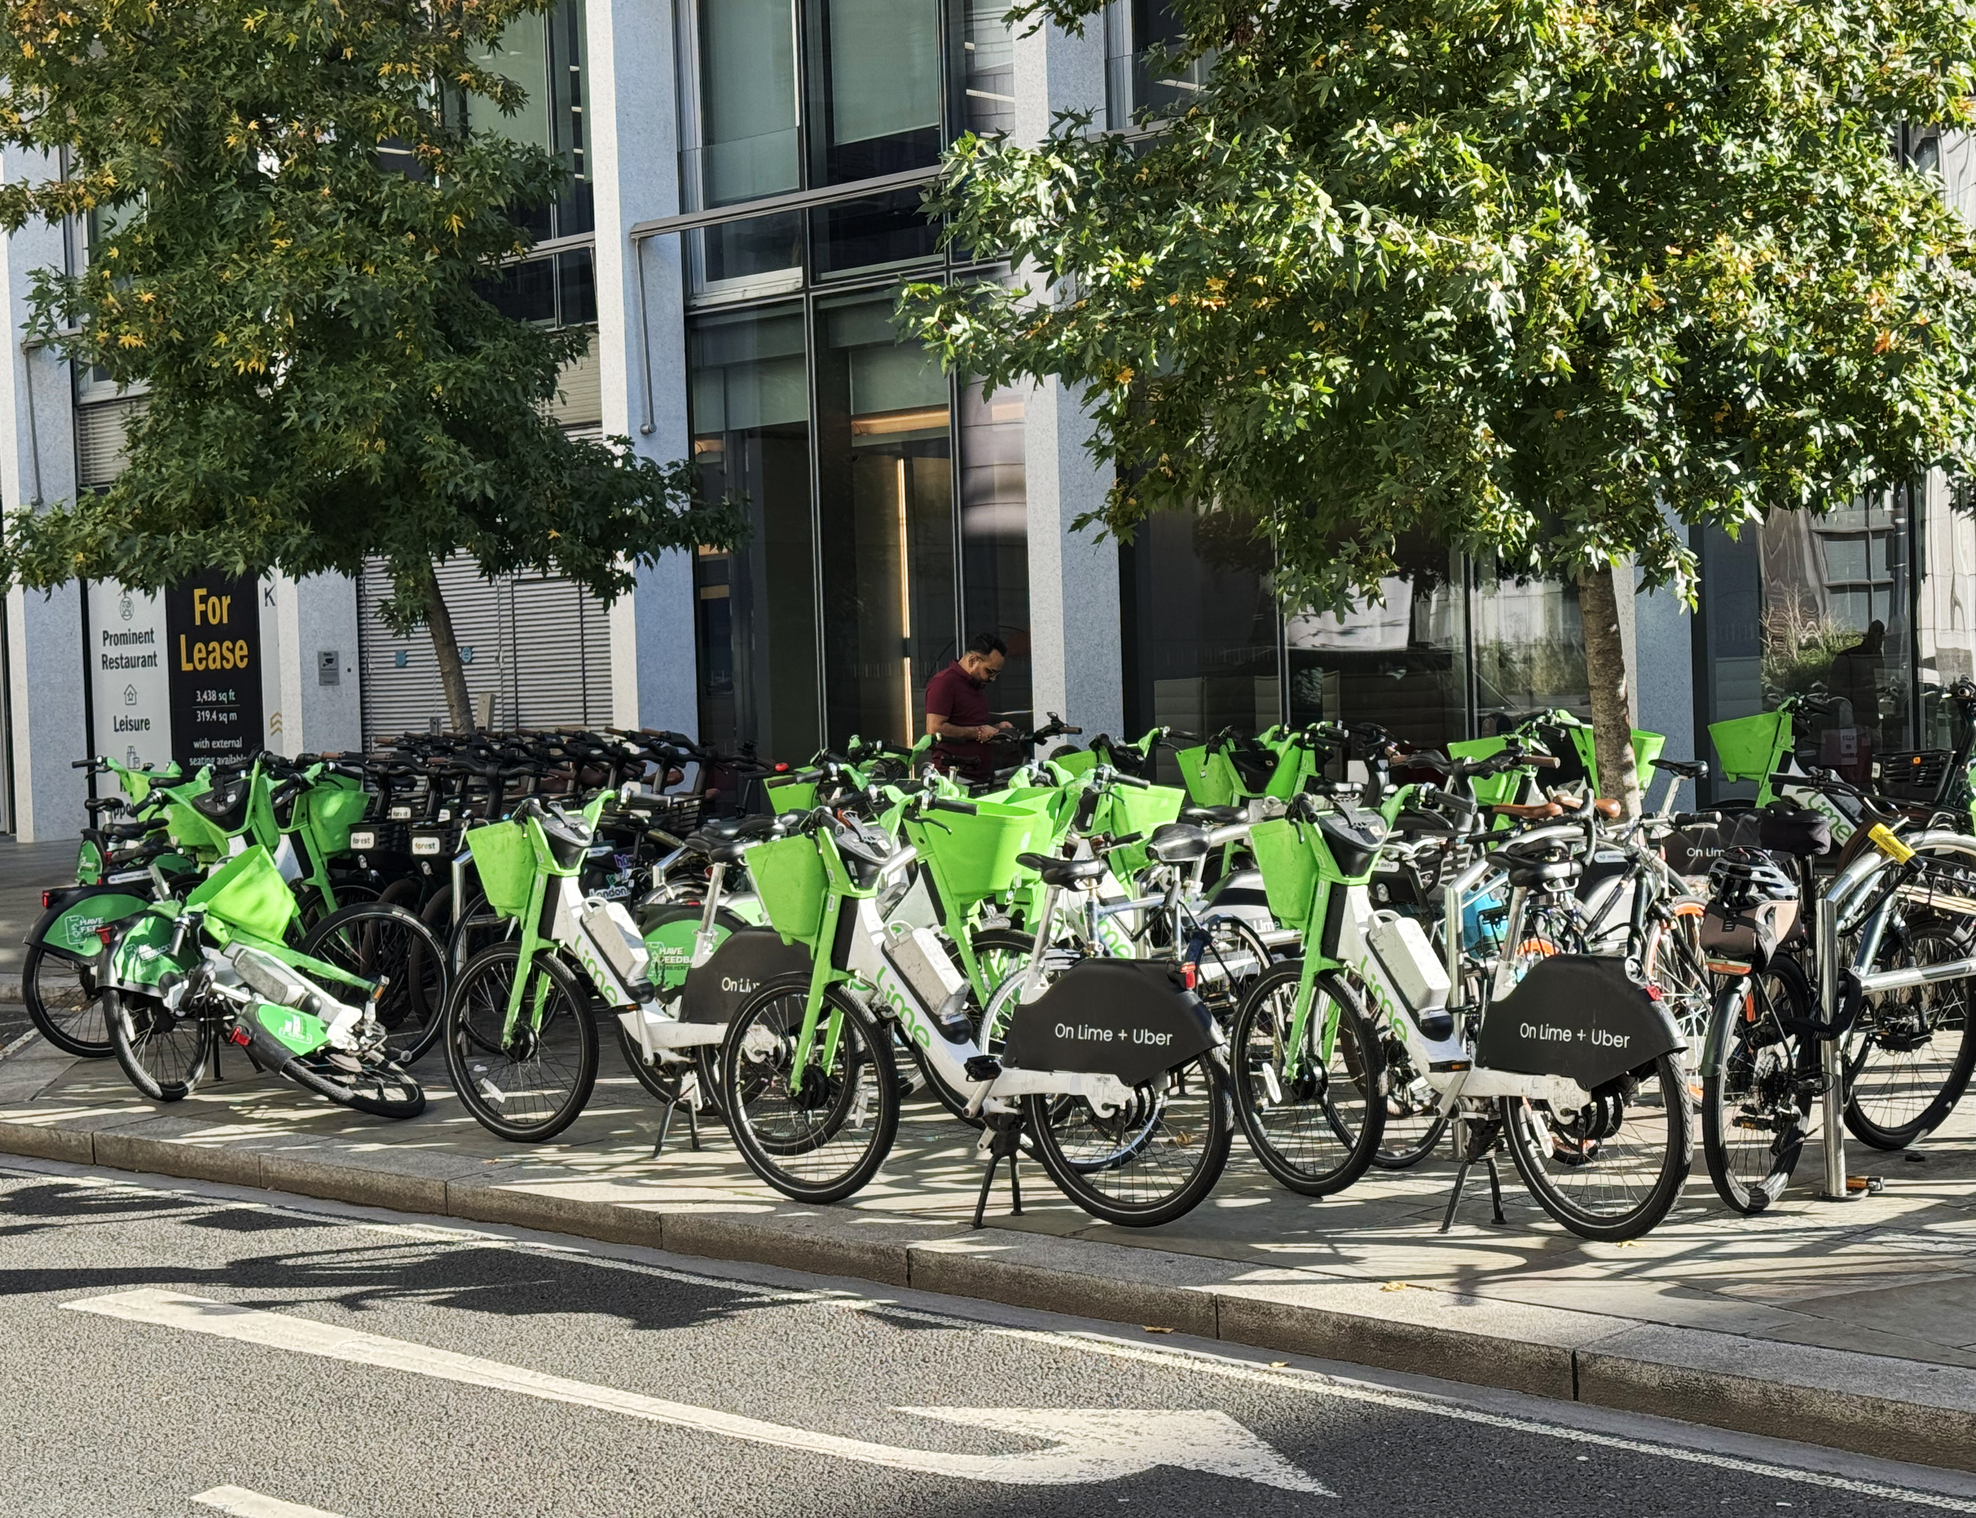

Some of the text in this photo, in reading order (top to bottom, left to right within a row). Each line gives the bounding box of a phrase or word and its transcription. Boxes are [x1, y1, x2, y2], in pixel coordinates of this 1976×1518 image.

[193, 587, 232, 626] For
[102, 627, 155, 647] Prominent
[101, 650, 158, 671] Restaurant
[180, 634, 249, 672] Lease
[196, 689, 236, 704] 3,438 sq ft
[113, 715, 151, 733] Leisure
[196, 710, 238, 725] 319.4 sq m
[193, 736, 243, 749] with external
[189, 754, 215, 766] seating
[1806, 790, 1852, 841] Lime
[1686, 846, 1725, 857] On Lim
[79, 917, 105, 926] HAVE
[659, 946, 684, 955] HAVE
[574, 934, 618, 1005] Lime
[721, 976, 738, 992] On
[875, 965, 931, 1050] Lime
[1360, 955, 1408, 1043] Lime
[1054, 1023, 1174, 1047] On Lime + Uber
[1519, 1021, 1631, 1049] On Lime + Uber
